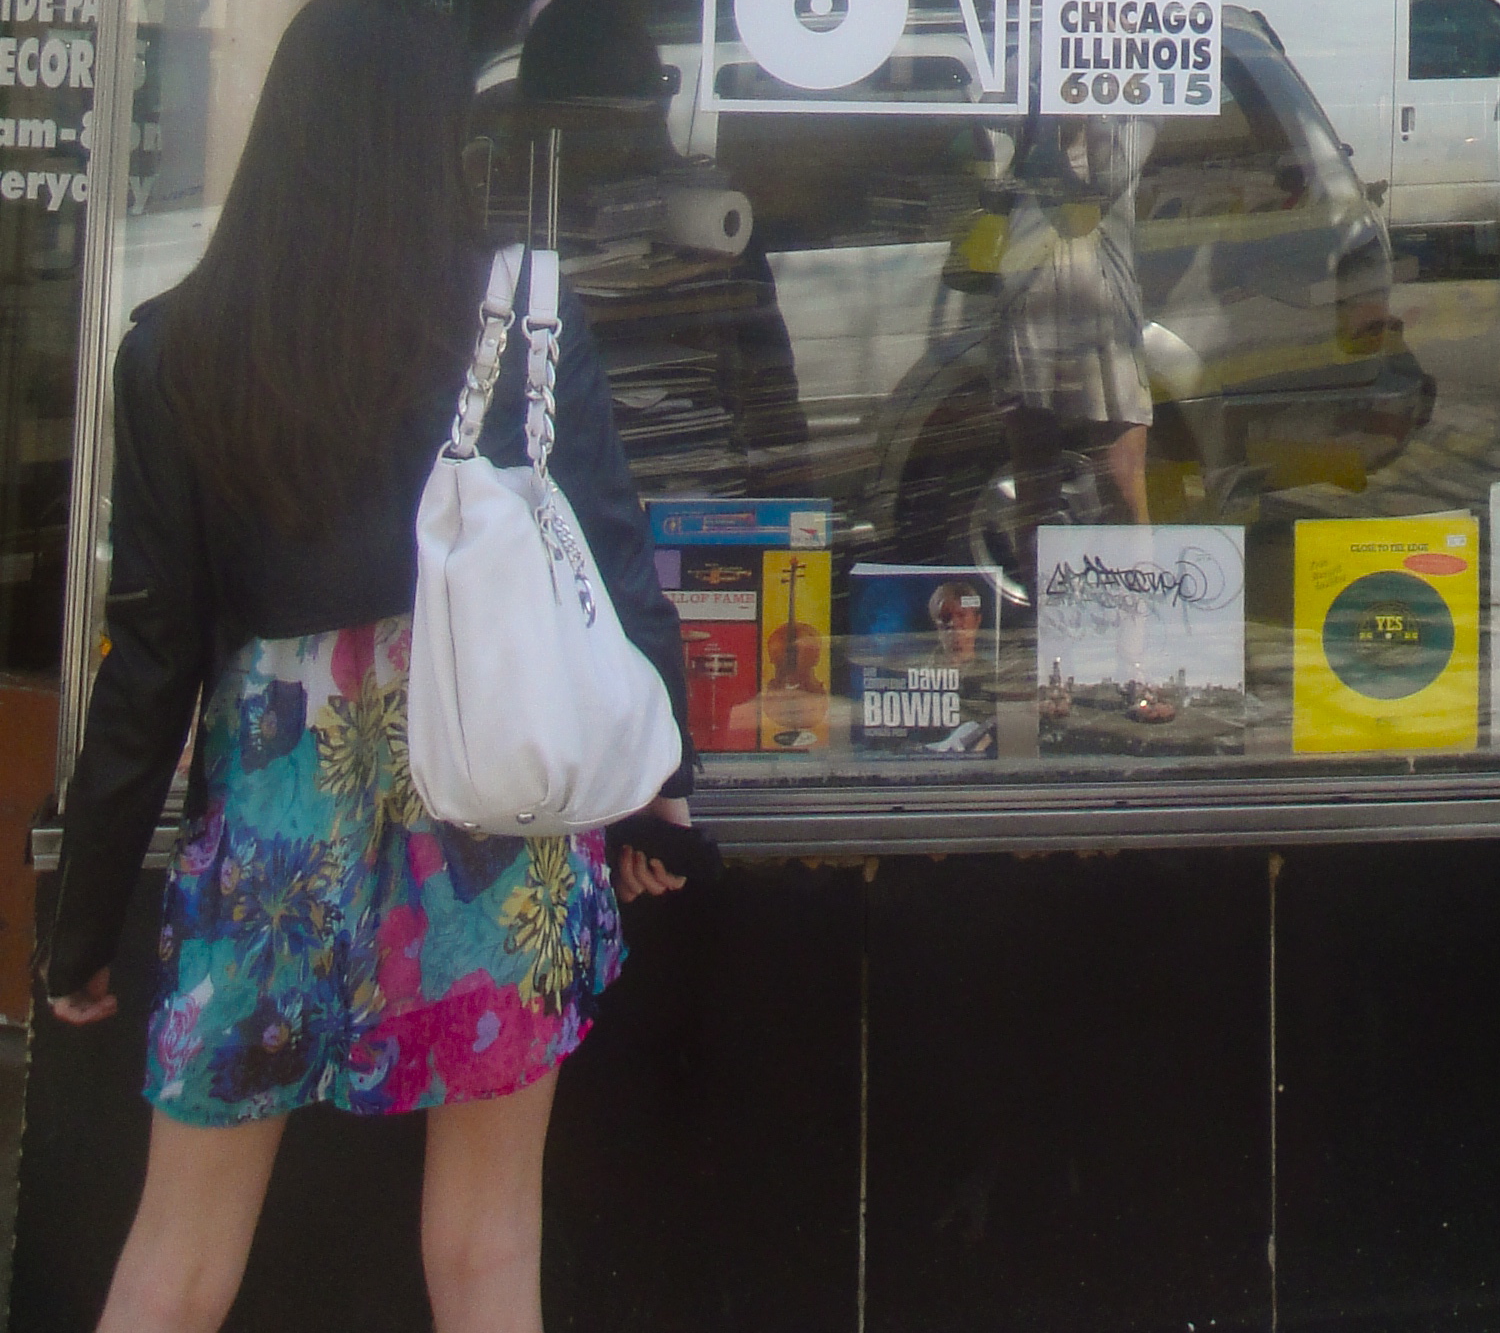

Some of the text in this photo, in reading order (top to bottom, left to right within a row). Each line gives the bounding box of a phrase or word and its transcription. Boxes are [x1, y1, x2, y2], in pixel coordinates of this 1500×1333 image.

[1060, 0, 1214, 35] CHICAGO
[1060, 37, 1212, 71] ILLINOIS
[1060, 71, 1213, 106] 60615
[713, 593, 755, 604] FAME
[1375, 615, 1403, 631] YES
